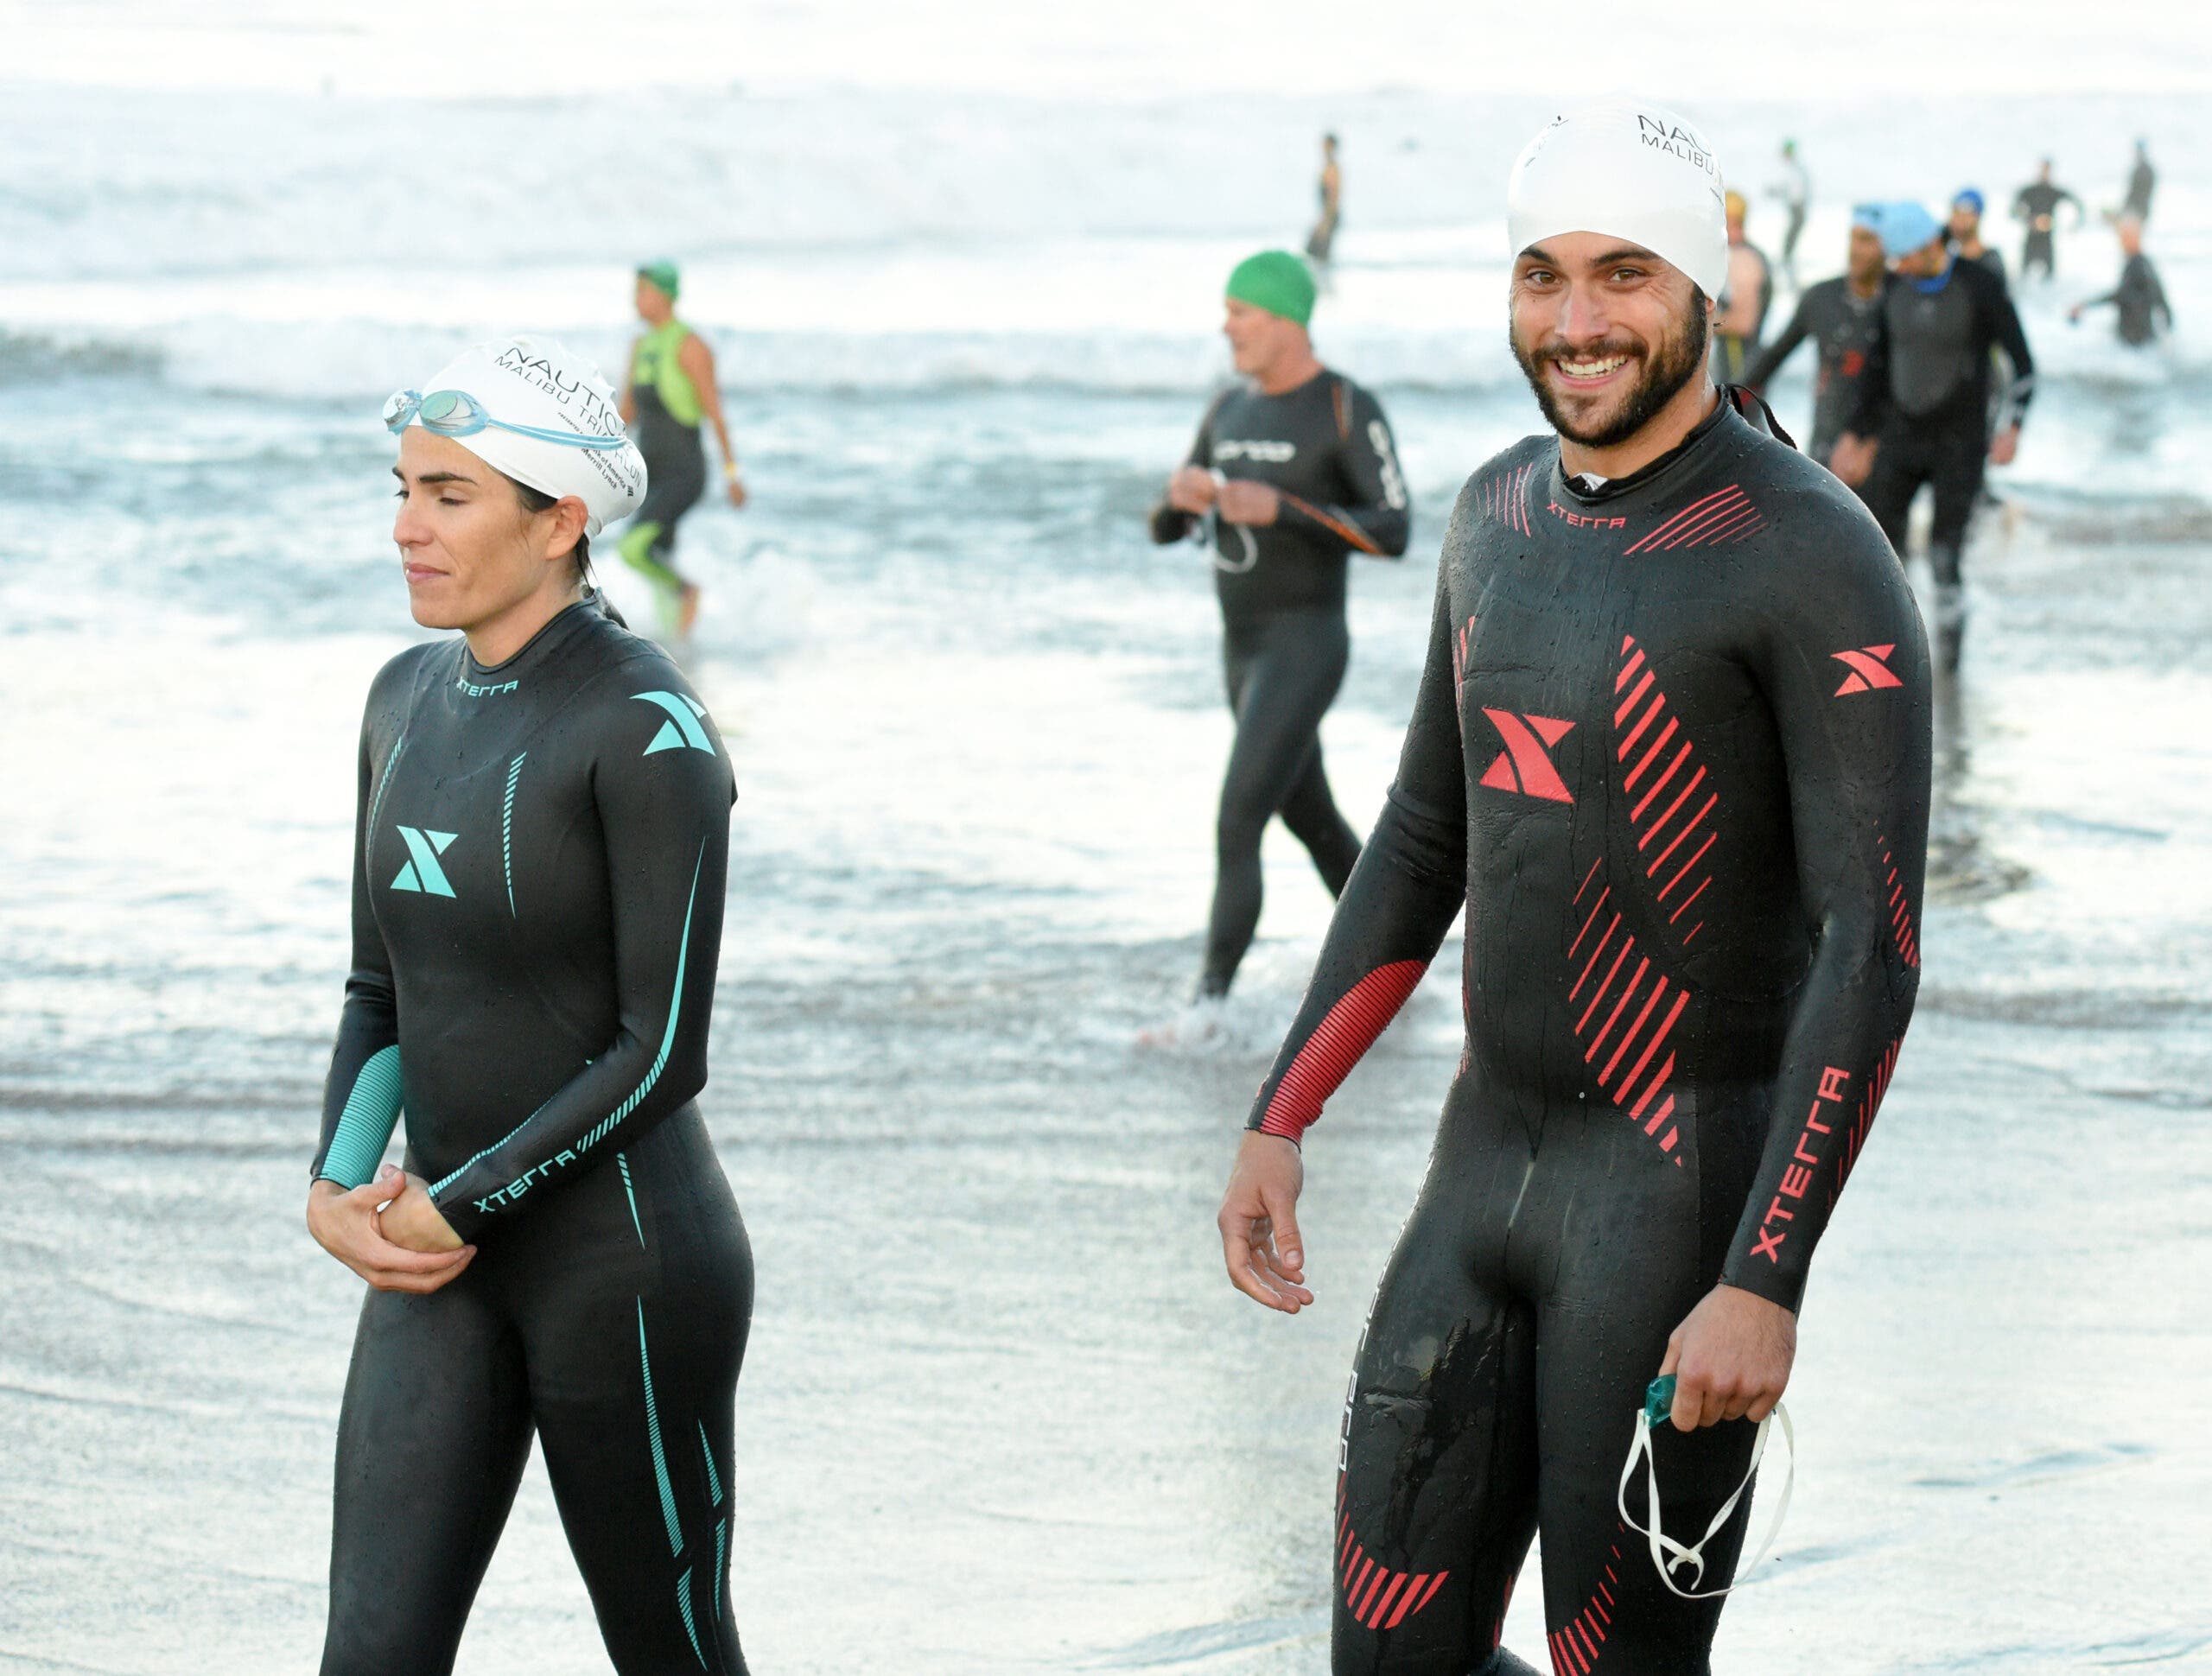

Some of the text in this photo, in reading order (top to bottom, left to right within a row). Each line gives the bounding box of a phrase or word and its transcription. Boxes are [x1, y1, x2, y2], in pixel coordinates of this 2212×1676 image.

[1642, 133, 1714, 176] MALIBU
[493, 355, 570, 405] MALIBU
[504, 346, 626, 437] NAUTIC
[581, 448, 618, 491] Merrill Lynch
[607, 463, 627, 490] America
[1546, 499, 1626, 530] XTERRA
[455, 676, 519, 697] XTERRA
[472, 1149, 577, 1213] XTERRA
[1749, 1065, 1852, 1264] XTERRA
